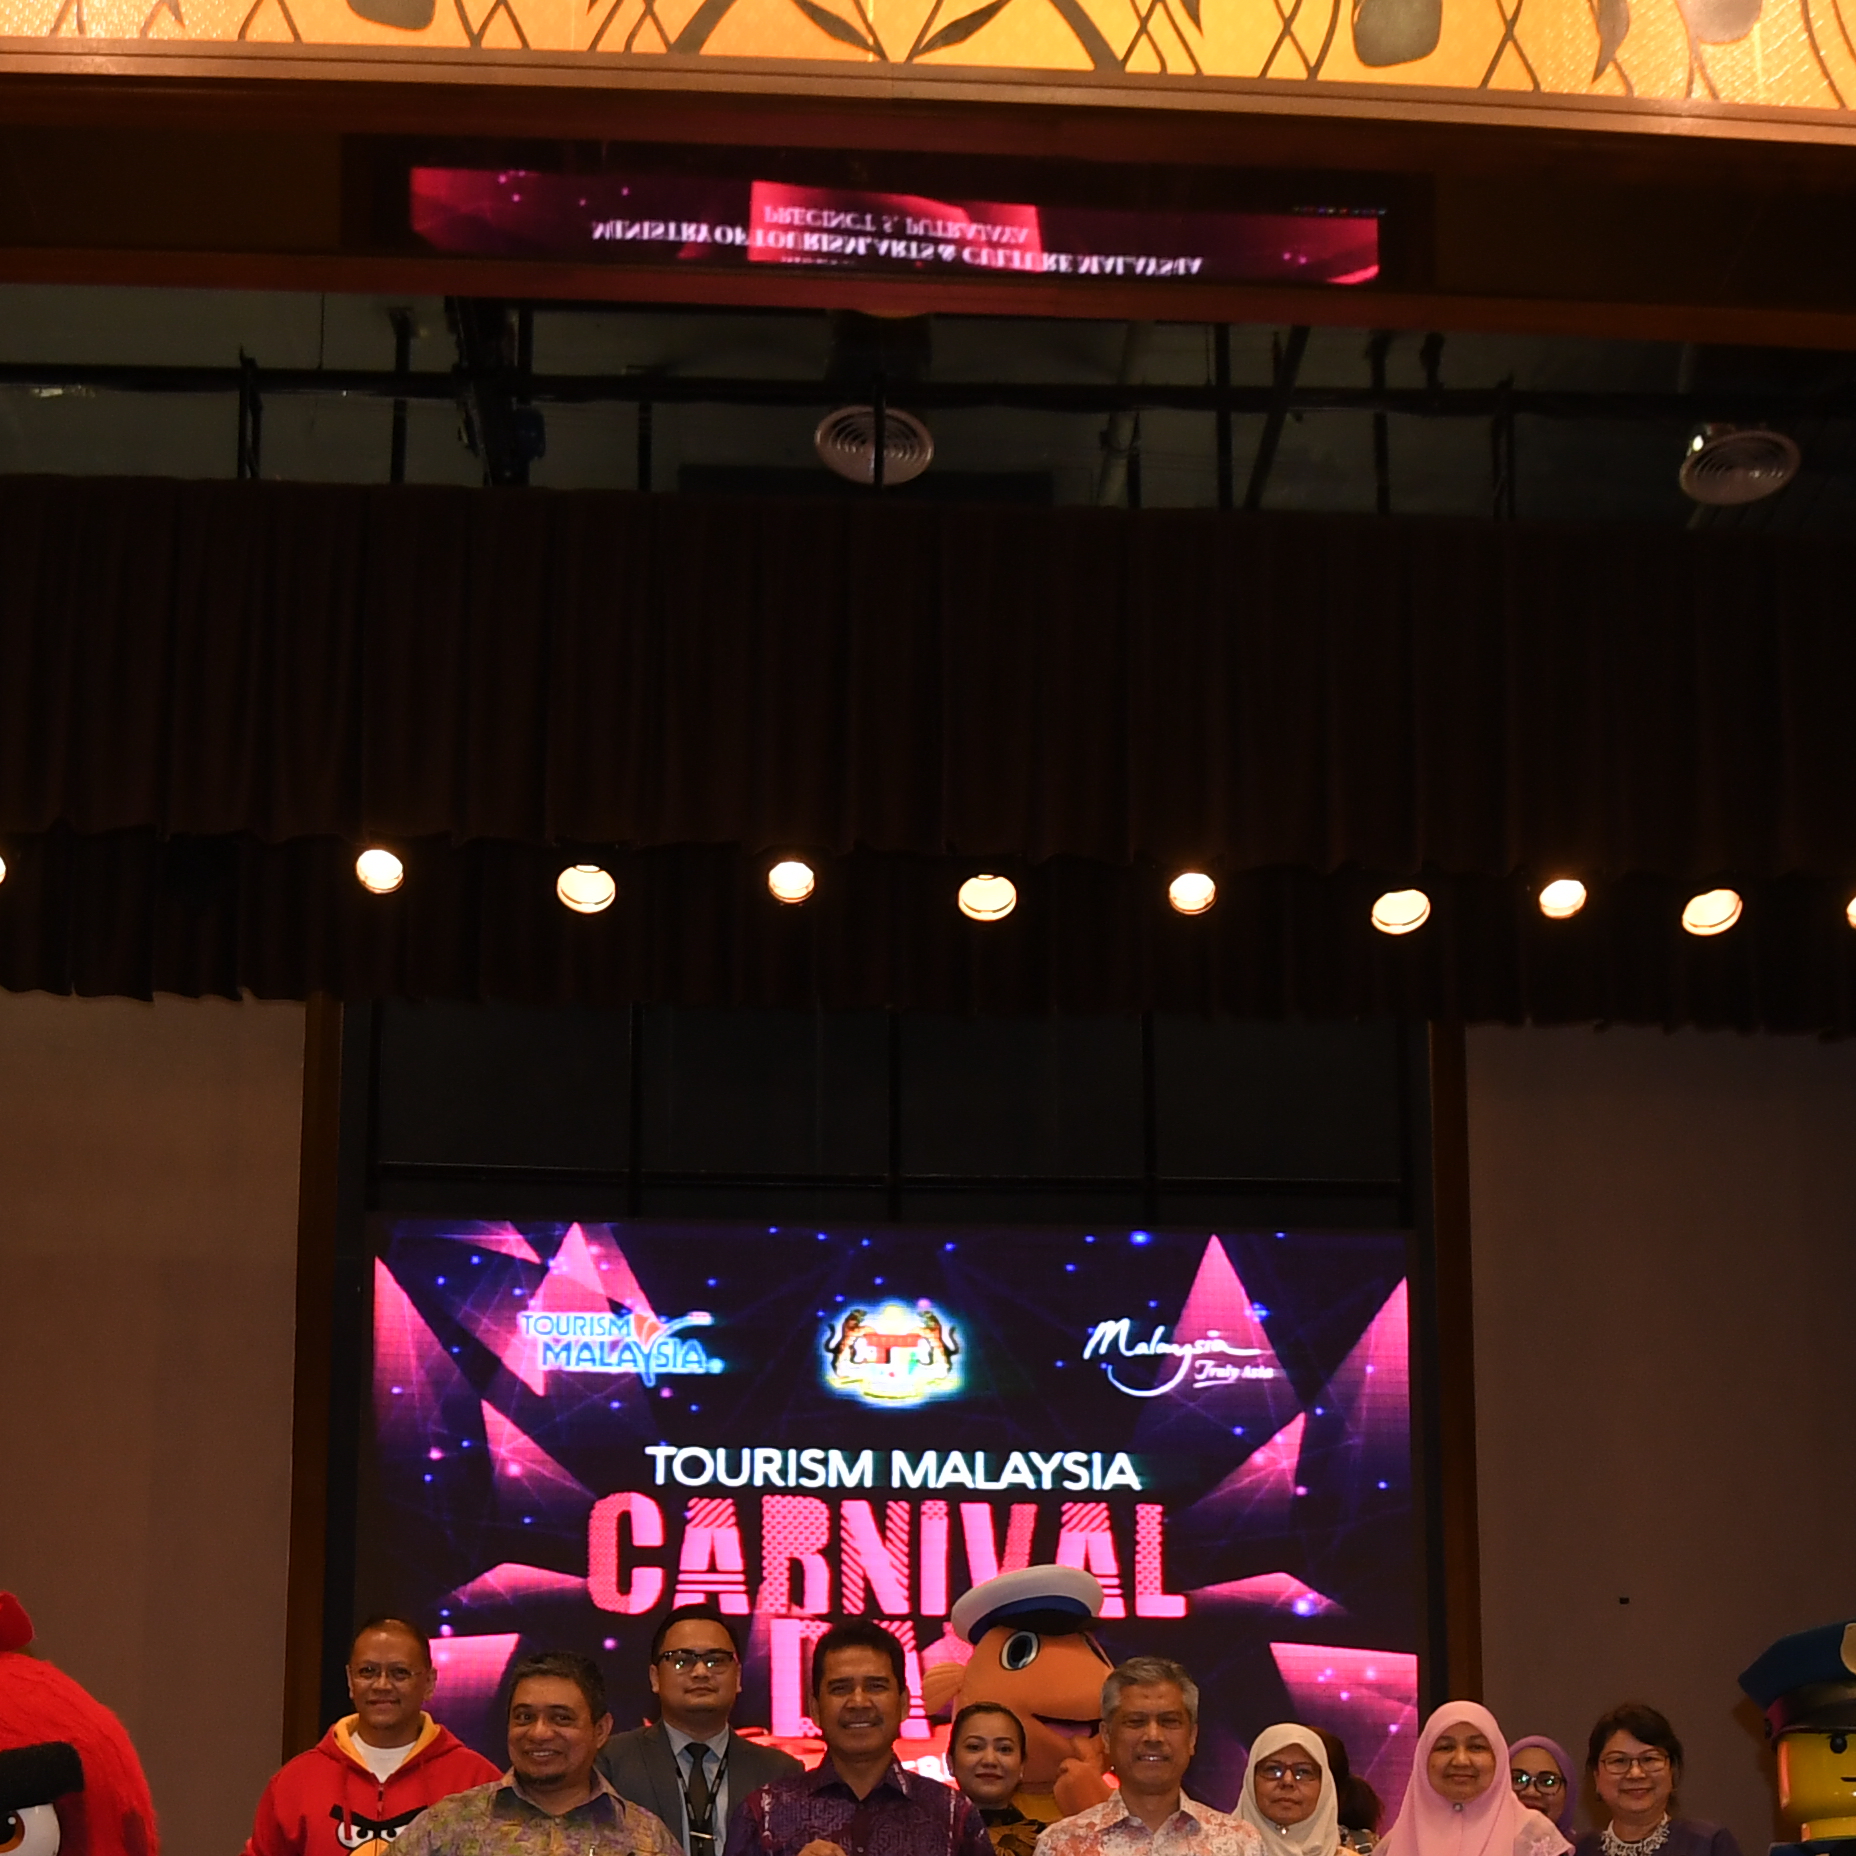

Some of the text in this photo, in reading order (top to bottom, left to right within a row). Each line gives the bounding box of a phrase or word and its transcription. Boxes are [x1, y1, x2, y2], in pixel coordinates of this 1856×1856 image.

[521, 1314, 631, 1336] TOURISM
[543, 1338, 707, 1385] MALAYSIA
[645, 1445, 1142, 1491] TOURISM MALAYSIA
[587, 1491, 1187, 1618] CARNIVAL
